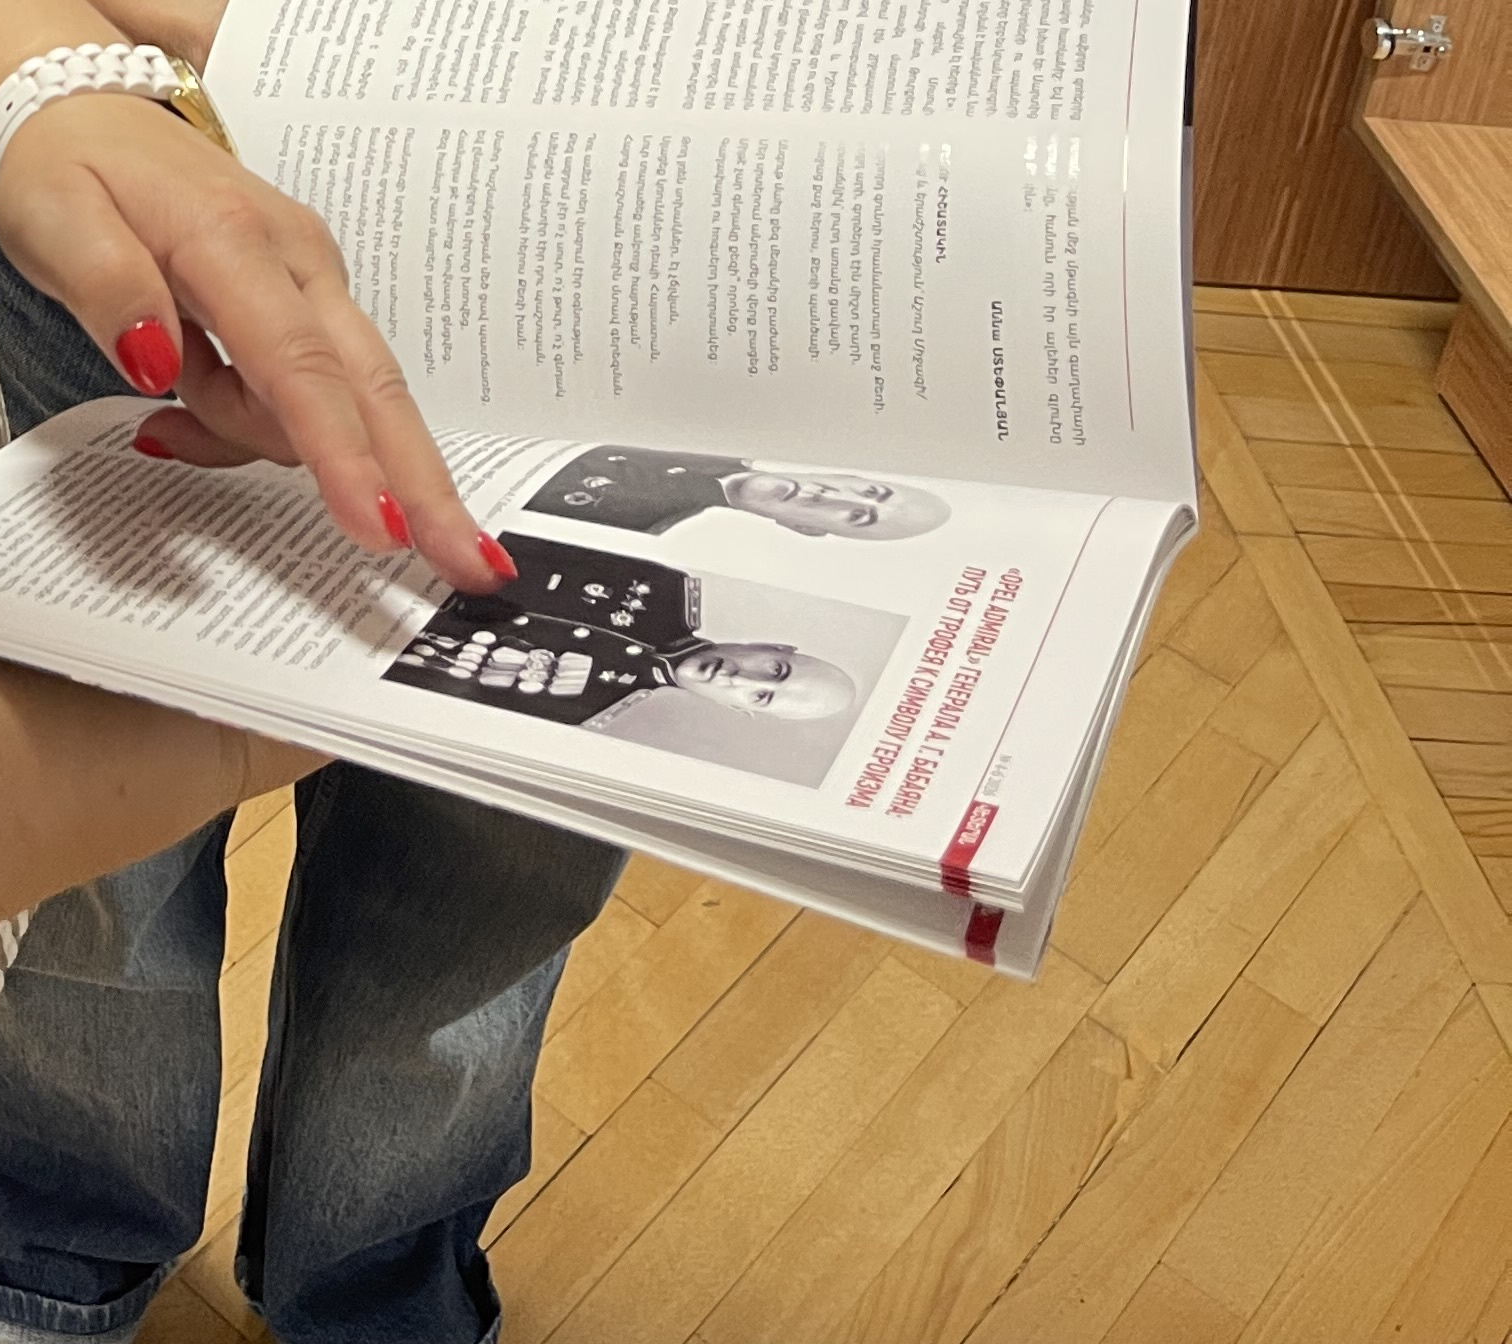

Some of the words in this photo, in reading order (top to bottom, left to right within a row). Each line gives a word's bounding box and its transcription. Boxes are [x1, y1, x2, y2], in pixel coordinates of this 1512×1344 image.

[935, 185, 949, 264] ՀԻՇԱՏԱԿԻՆ
[991, 300, 1003, 342] Աննա
[992, 347, 1010, 442] ՍՏԵՓԱՆՅԱՆ
[946, 597, 973, 615] ОТ
[954, 566, 987, 596] ПУТЬ
[990, 567, 1024, 603] «OPEL
[920, 615, 965, 666] ТРОФЕЯ
[966, 603, 1010, 665] ADMIRAL»
[914, 665, 941, 678] К
[931, 666, 982, 730] ГЕНЕРАЛА
[884, 677, 935, 742] СИМВОЛУ
[844, 740, 903, 808] ГЕРОИЗМА
